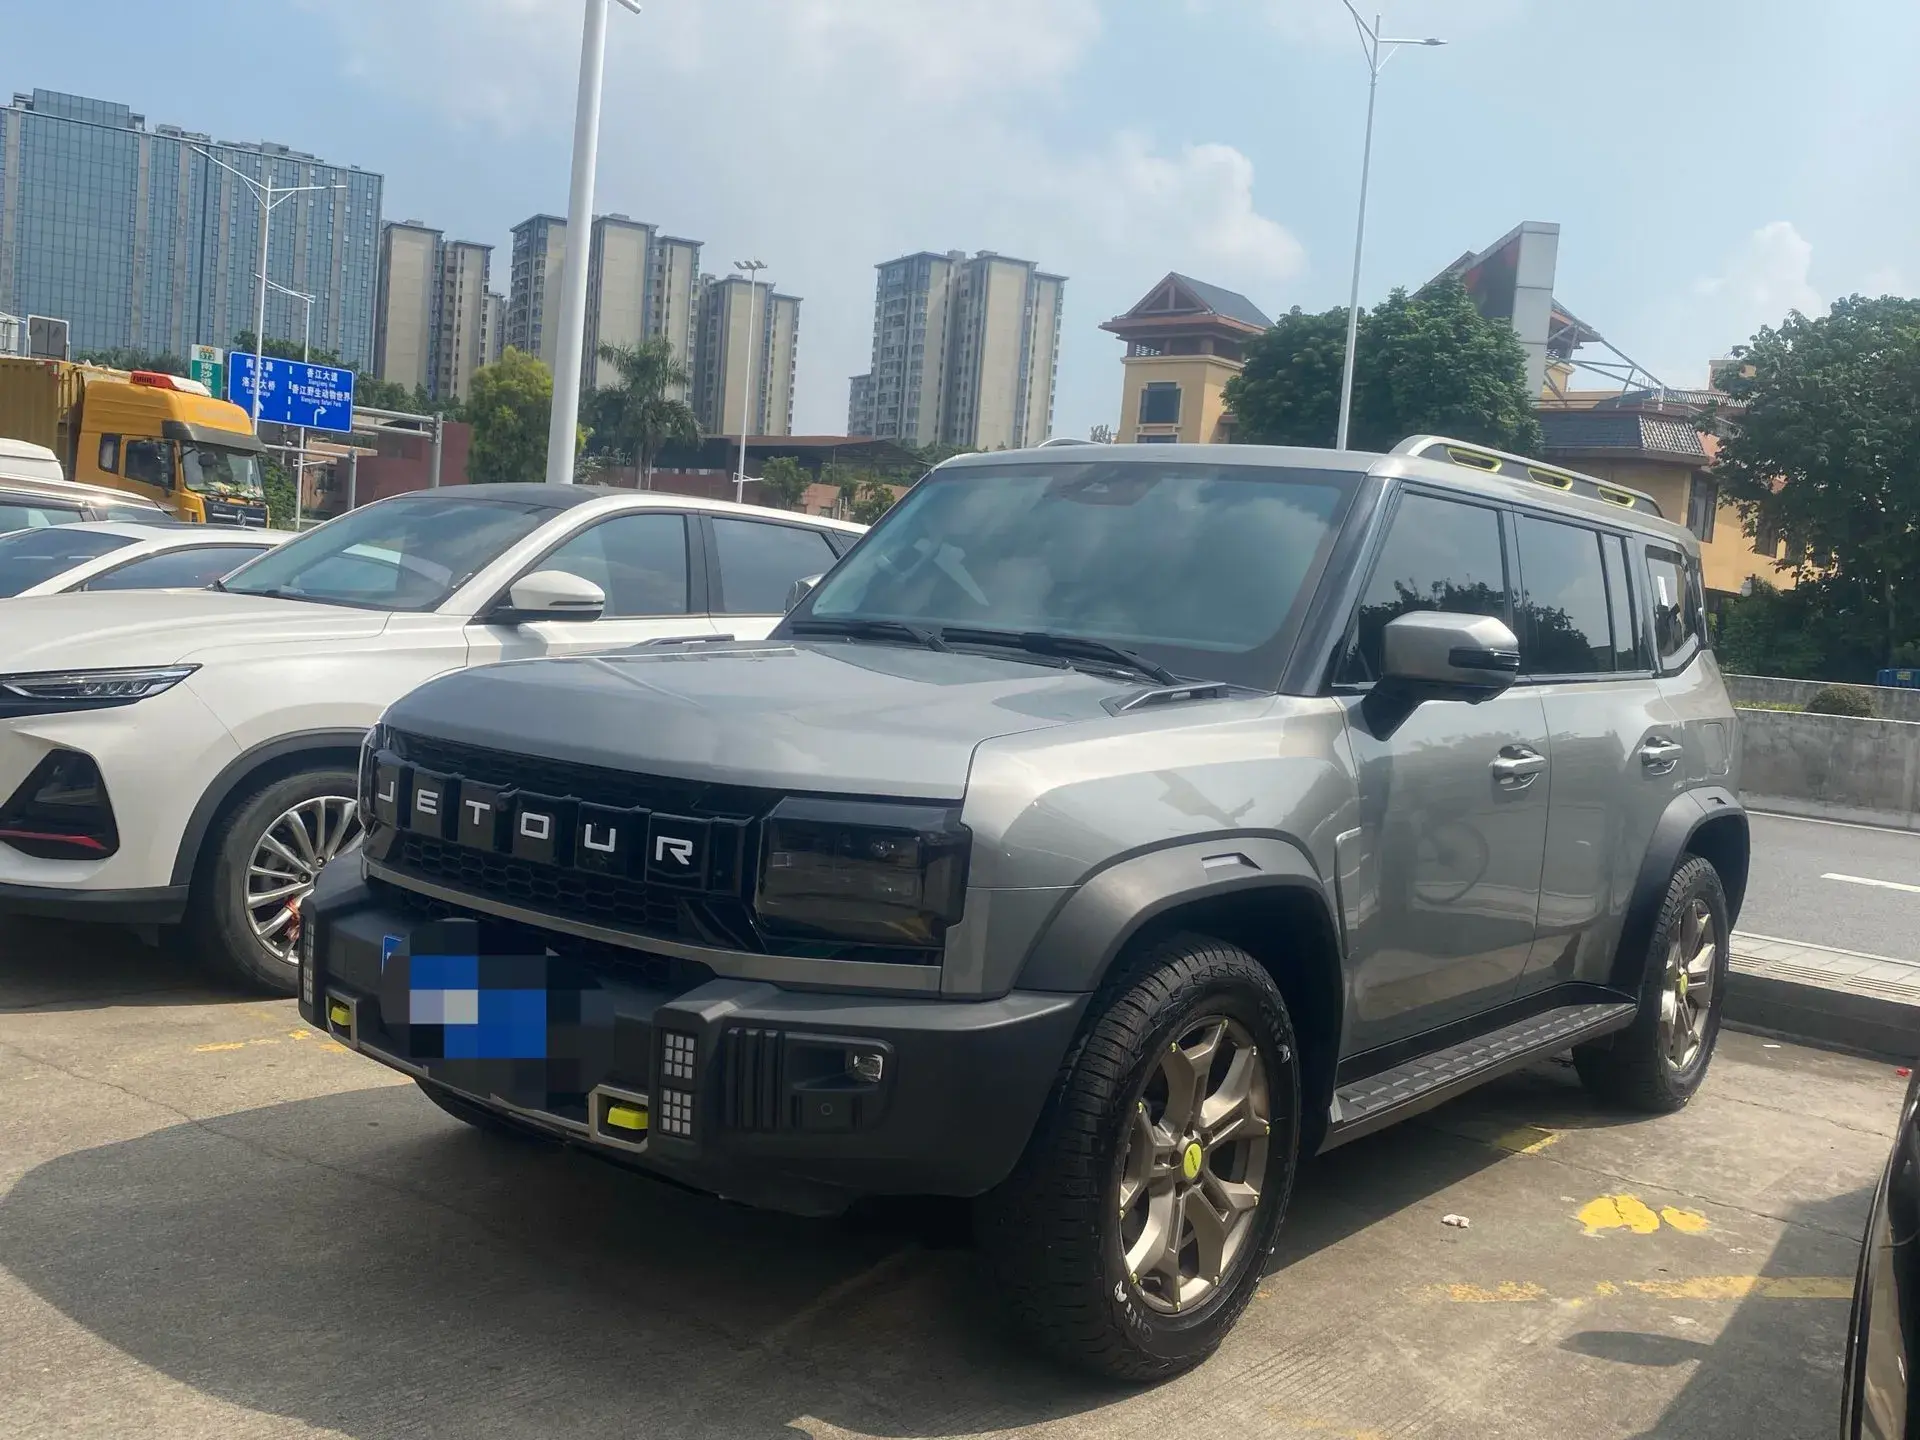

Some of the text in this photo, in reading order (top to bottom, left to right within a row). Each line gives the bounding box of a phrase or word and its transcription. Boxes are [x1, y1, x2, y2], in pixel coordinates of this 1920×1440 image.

[200, 362, 213, 391] 南沙港
[307, 368, 338, 382] 香江大道
[291, 384, 351, 402] 香江野生动物世界
[378, 781, 693, 867] JETOUR
